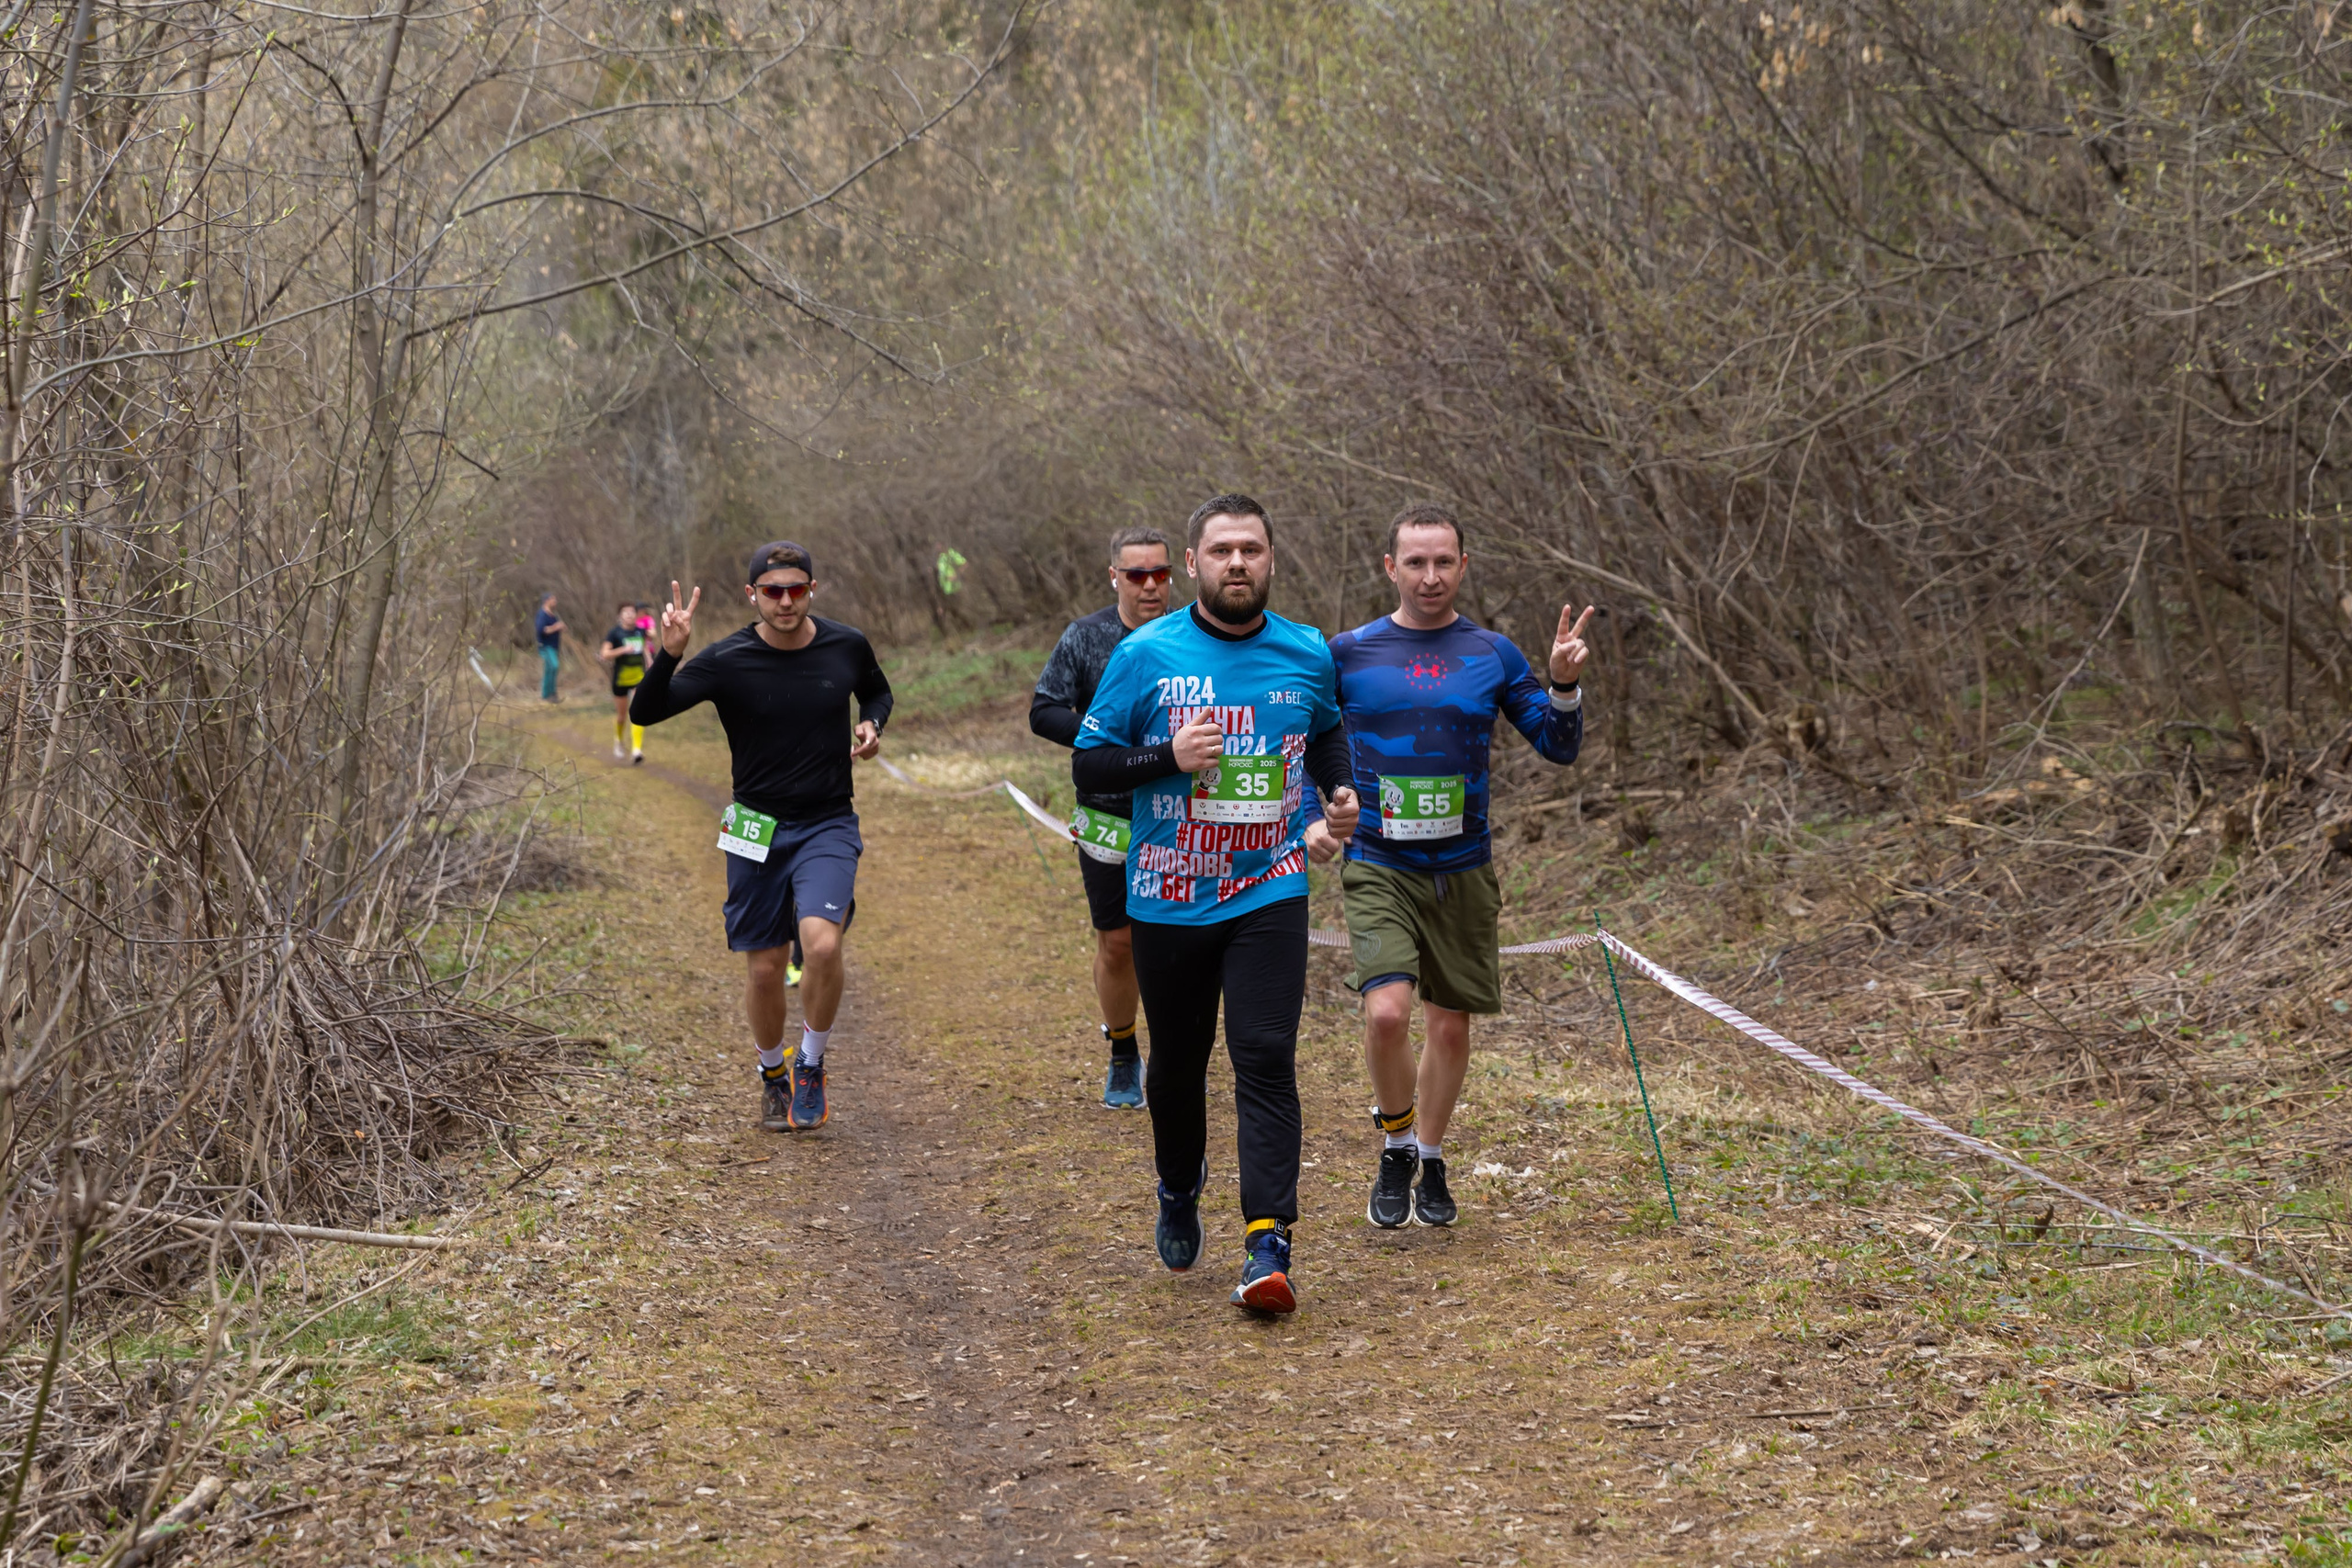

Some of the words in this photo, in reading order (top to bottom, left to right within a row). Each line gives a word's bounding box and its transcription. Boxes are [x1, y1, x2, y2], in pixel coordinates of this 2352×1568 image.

[1158, 676, 1216, 706] 2024
[1223, 736, 1268, 756] 024
[1126, 753, 1159, 767] KIPSTA
[1235, 773, 1270, 796] 35
[1418, 793, 1451, 816] 55
[742, 819, 762, 840] 15
[1096, 825, 1118, 847] 74
[1177, 820, 1288, 853] #ГОРДОСТЬ
[1138, 842, 1233, 878] #ЛЮБОВЬ
[1132, 869, 1196, 903] #ЗАБЕГ
